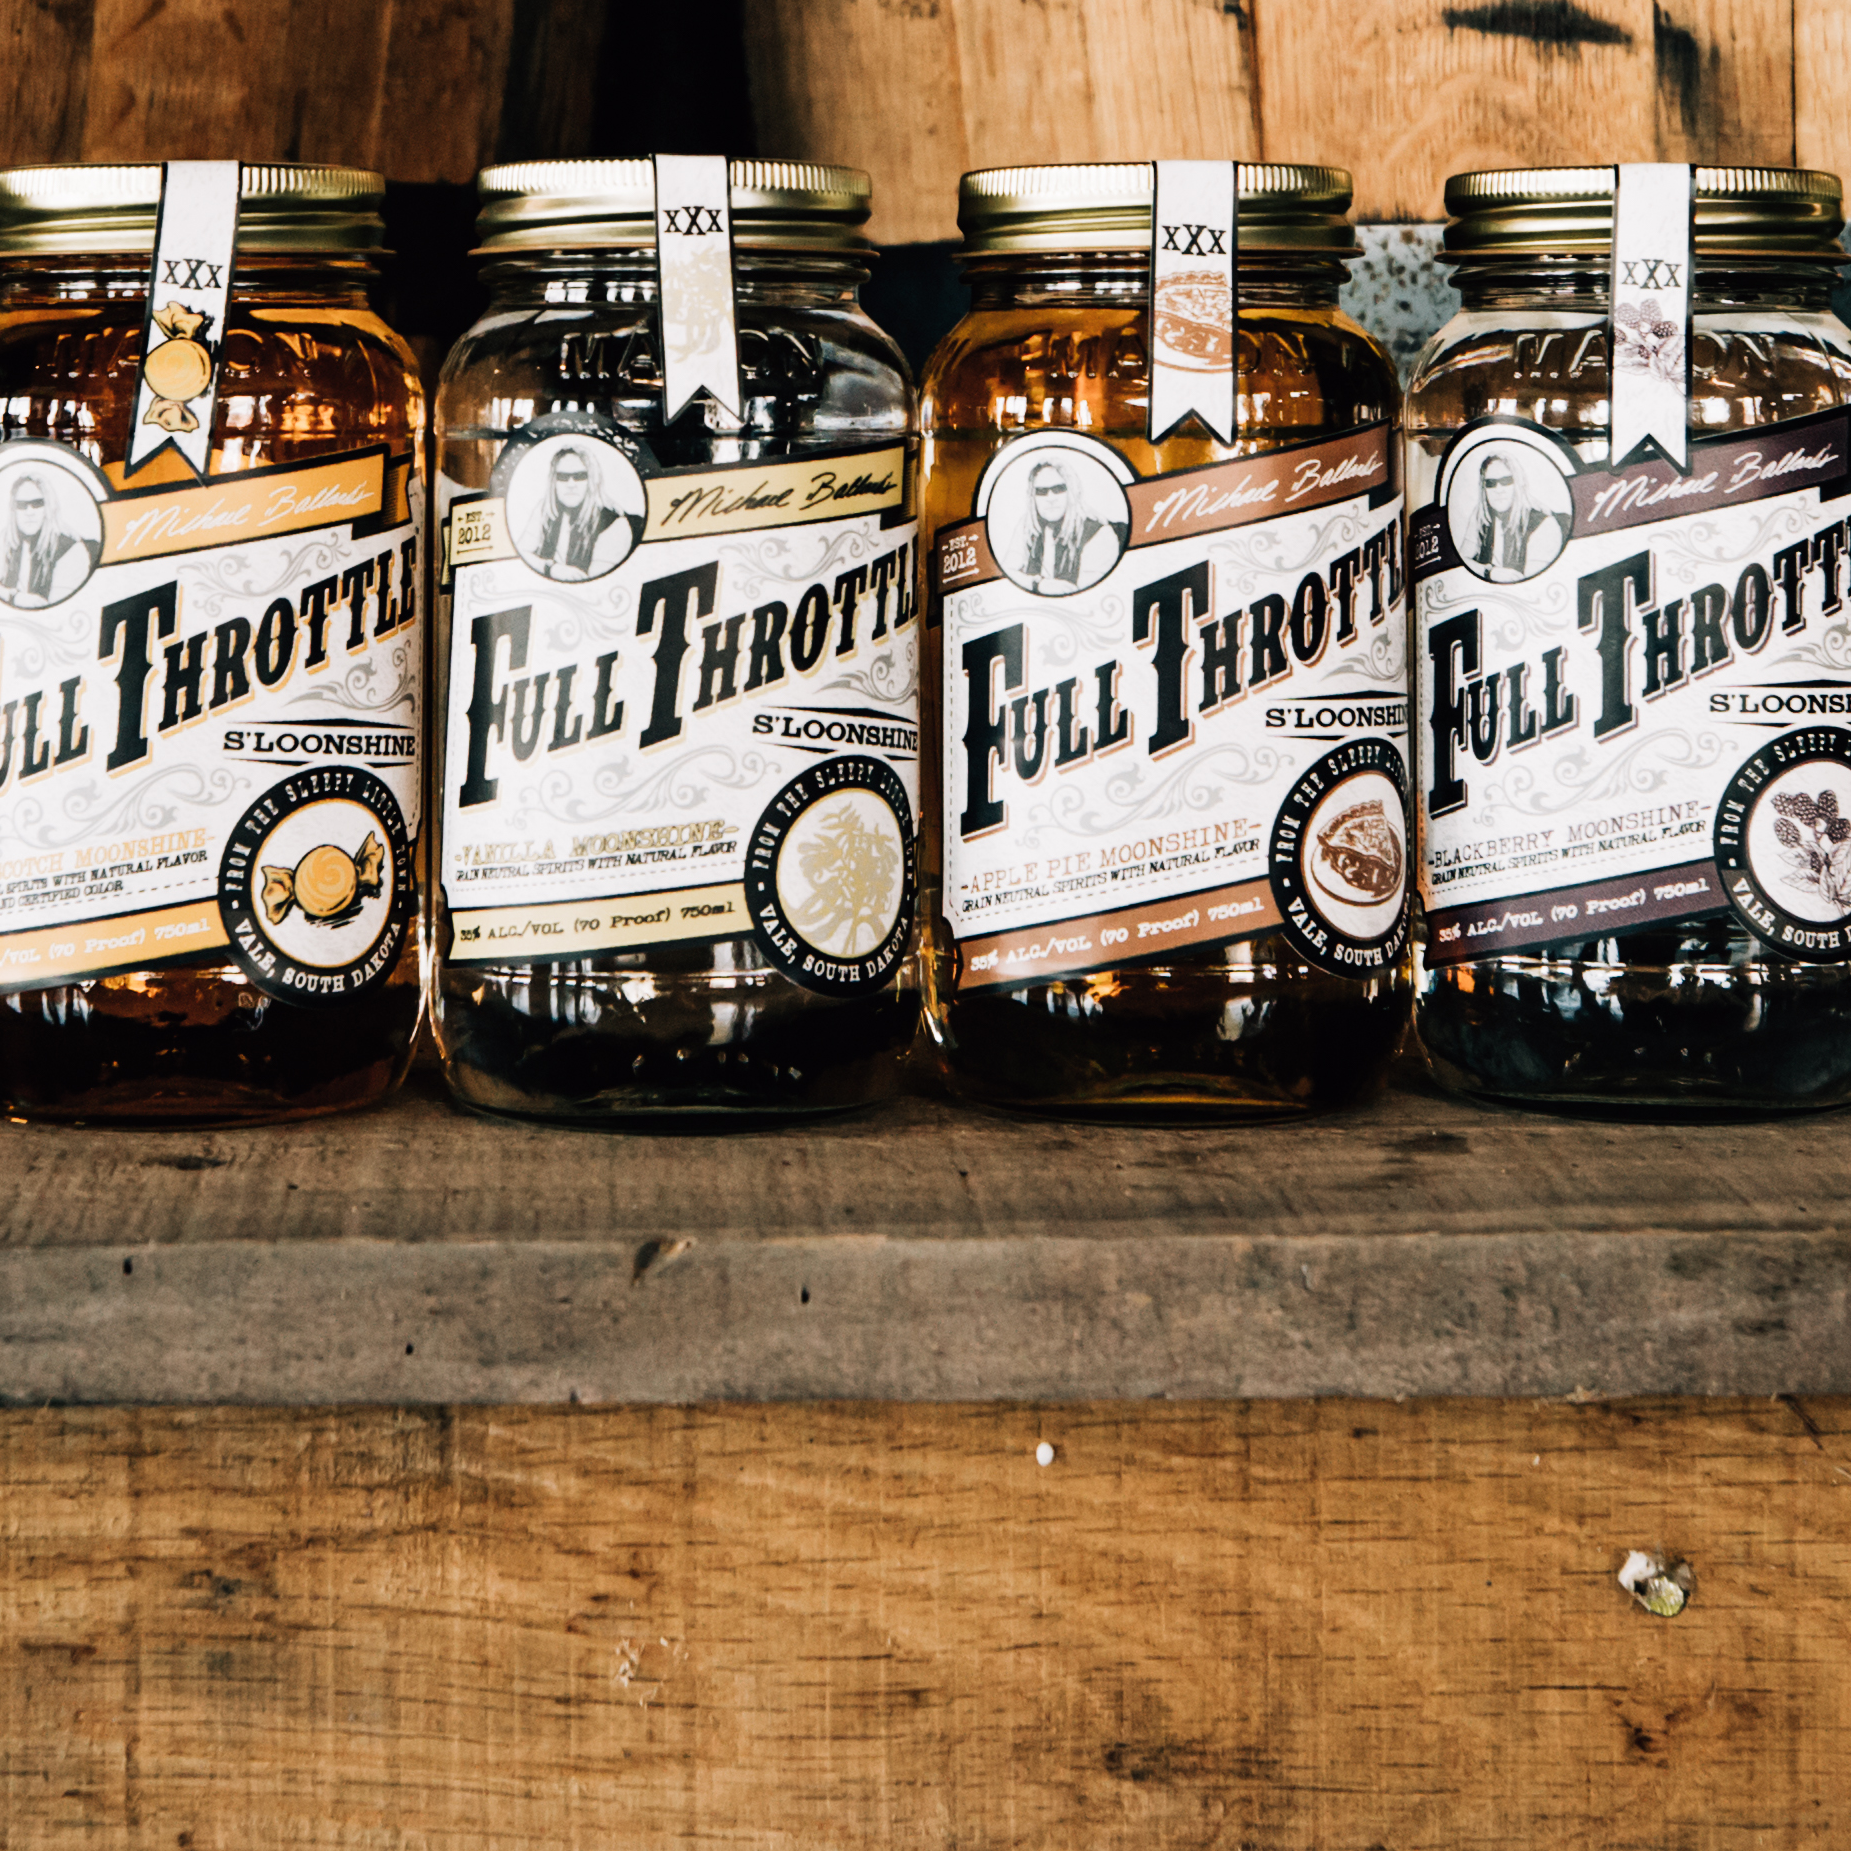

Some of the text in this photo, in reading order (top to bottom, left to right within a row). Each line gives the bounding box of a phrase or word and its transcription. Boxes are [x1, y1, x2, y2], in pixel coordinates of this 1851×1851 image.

[458, 525, 491, 545] 2012
[943, 548, 976, 568] 2012
[98, 535, 417, 782] THROTTLE
[959, 506, 1405, 842] FULL THROTTL
[458, 604, 629, 815] FULL
[1265, 706, 1408, 728] S'LOONSHIN
[1428, 608, 1579, 822] FULL
[223, 731, 415, 756] S'LOONSHINE
[1047, 852, 1091, 879] PIE
[1110, 865, 1146, 882] WITH
[1148, 852, 1211, 873] NATURAL
[574, 917, 600, 932] (70
[610, 907, 671, 929] Proof)
[681, 901, 735, 919] 750ml
[1100, 928, 1129, 946] (70
[1137, 909, 1200, 938] Proof)
[1207, 897, 1265, 920] 750ml
[1551, 904, 1578, 922] (70
[1586, 889, 1647, 914] Proof)
[1653, 877, 1710, 902] 750ml
[1733, 877, 1775, 935] VALE,
[1781, 924, 1840, 949] SOUTH
[49, 918, 210, 959] (70 Proof) 750ml
[759, 903, 908, 982] VALE, SOUTH DAKOTA
[1288, 896, 1383, 967] VALE, SOUTH
[235, 918, 401, 993] VALE, SOUTH DAKOTA
